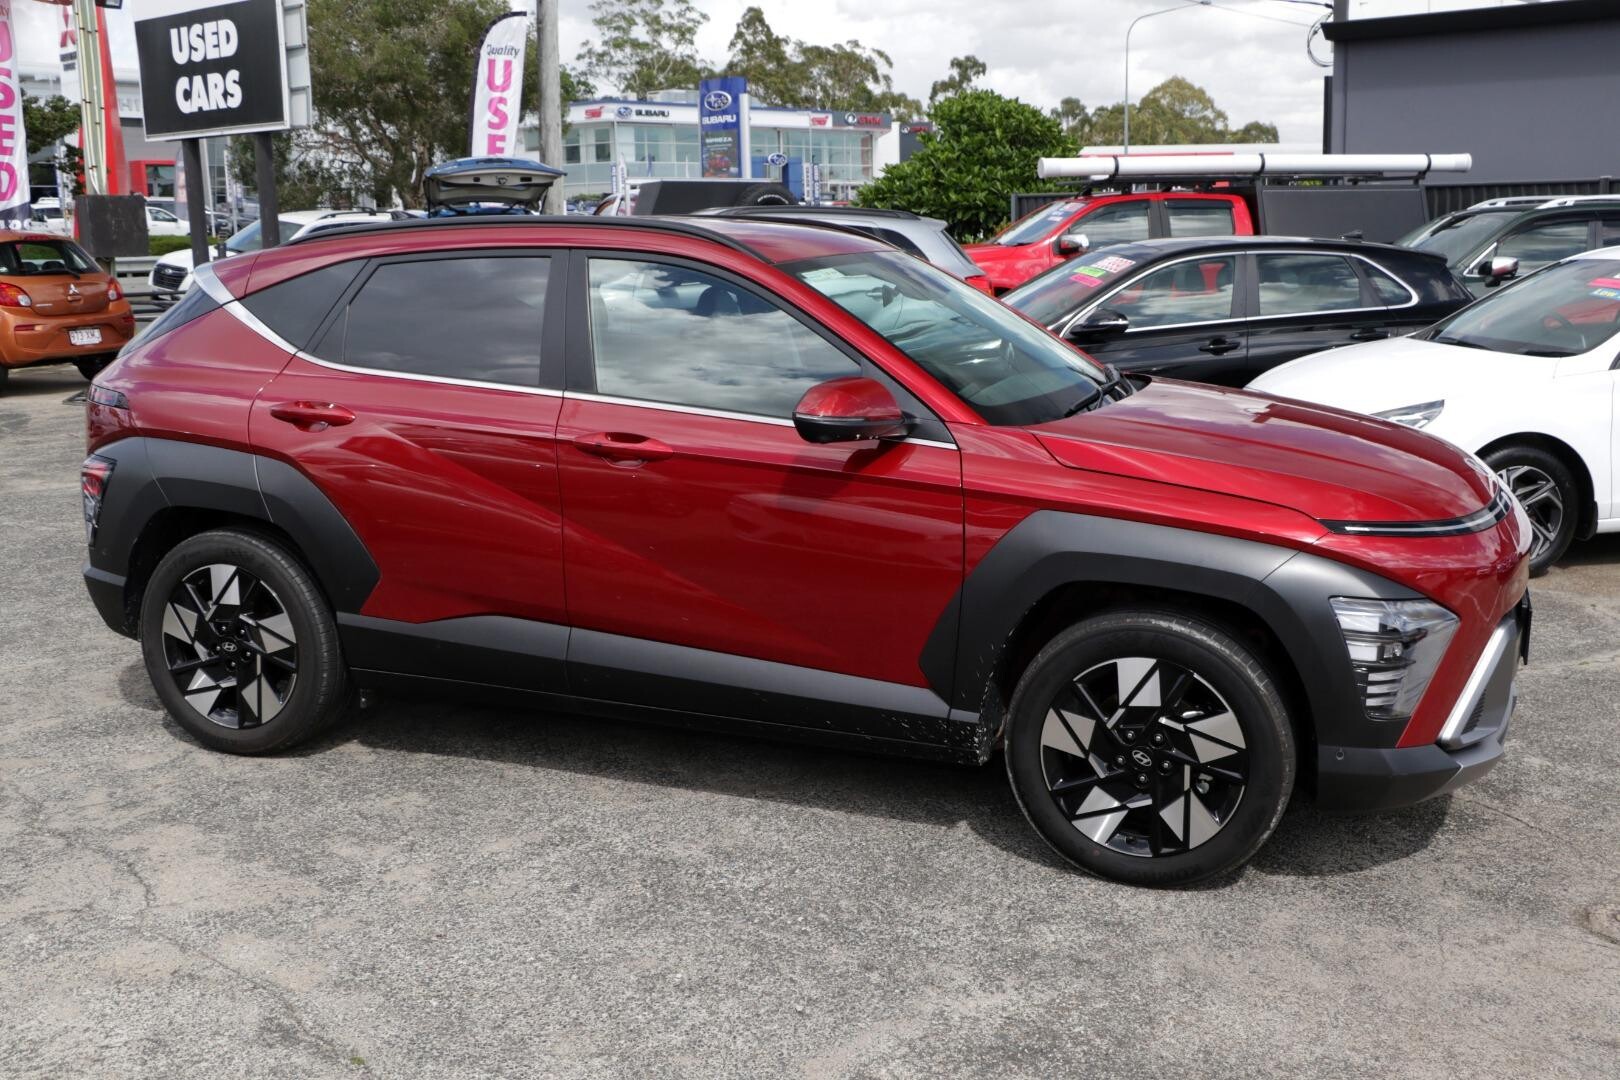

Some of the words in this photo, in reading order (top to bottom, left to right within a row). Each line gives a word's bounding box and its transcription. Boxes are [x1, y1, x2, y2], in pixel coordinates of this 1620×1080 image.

[170, 19, 238, 65] USED
[487, 44, 520, 58] Quality
[176, 69, 242, 114] CARS
[635, 108, 670, 118] SUBARU
[702, 114, 737, 125] SUBARU
